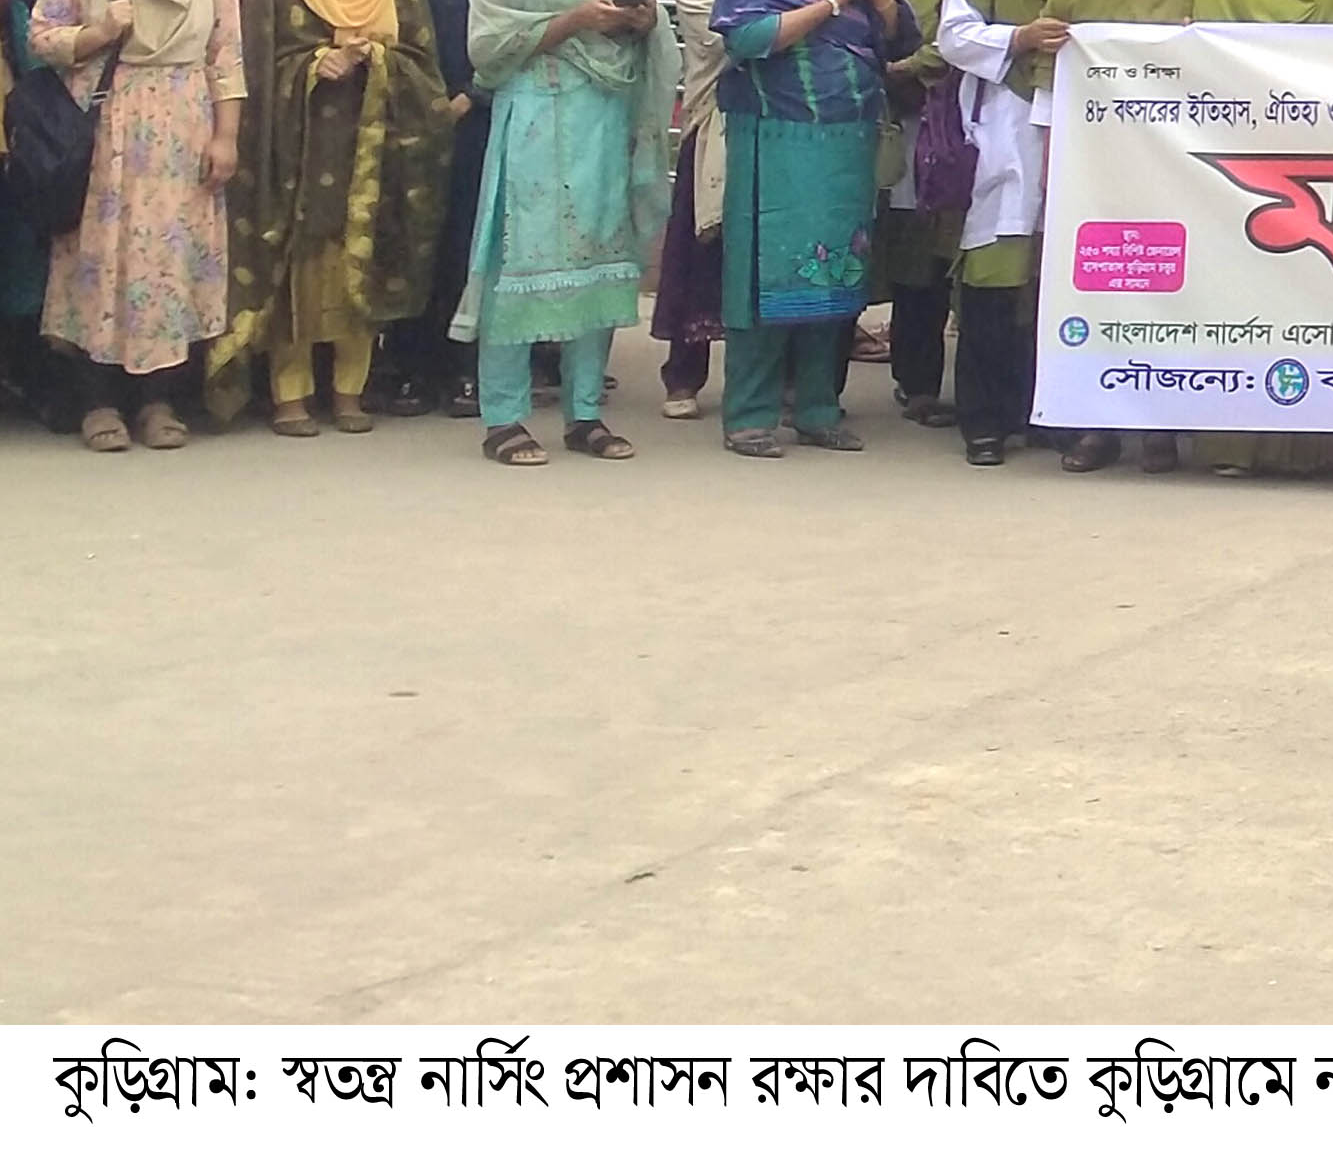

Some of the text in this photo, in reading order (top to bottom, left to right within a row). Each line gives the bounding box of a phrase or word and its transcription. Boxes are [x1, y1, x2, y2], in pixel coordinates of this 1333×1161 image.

[1086, 63, 1182, 80] সেবা ও শিক্ষা
[1085, 99, 1108, 123] ৪৮
[1113, 98, 1181, 124] বৎসরের
[1186, 90, 1258, 130] ইতিহাস,
[1264, 89, 1320, 127] ঐতিহ্য
[1100, 320, 1198, 344] বাংলাদেশ
[1204, 317, 1274, 345] নার্সেস
[1099, 359, 1256, 395] সৌজন্যে:
